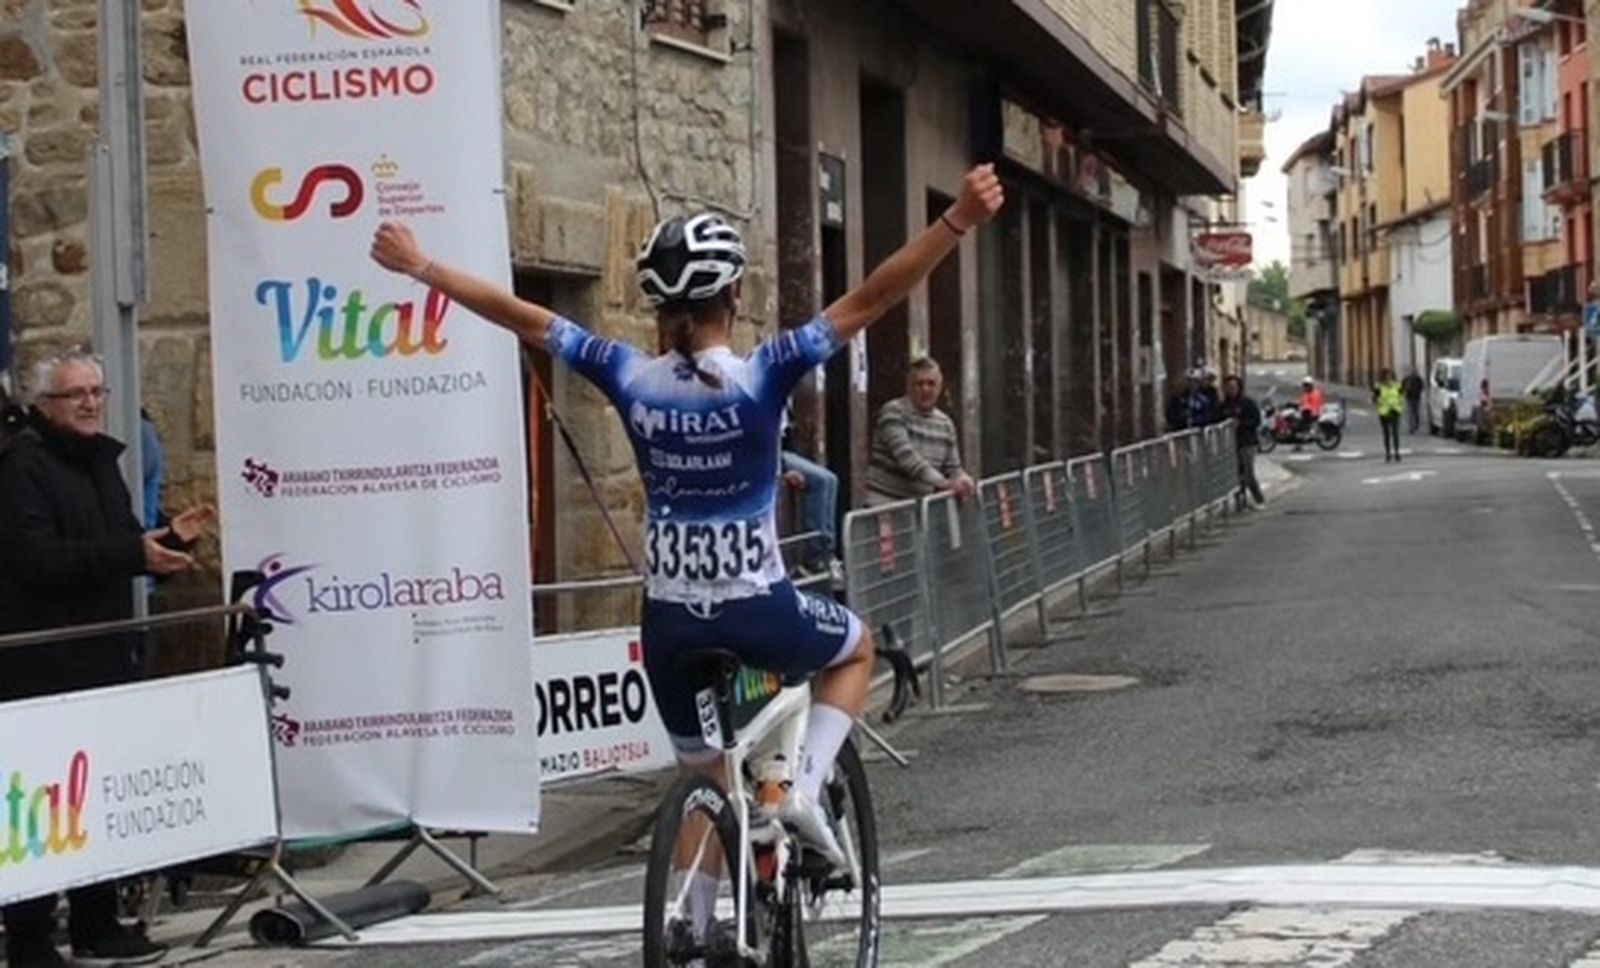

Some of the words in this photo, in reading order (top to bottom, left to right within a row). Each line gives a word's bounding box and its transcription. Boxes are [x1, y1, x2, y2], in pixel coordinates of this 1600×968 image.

[240, 55, 272, 65] REAL
[242, 64, 434, 104] CICLISMO
[255, 276, 449, 363] Vital
[241, 379, 352, 402] FUNDACIÓN
[367, 370, 487, 399] FUNDAZIOA
[306, 568, 504, 612] kirolaraba
[0, 750, 89, 864] tal
[105, 798, 207, 840] FUNDAZIOA
